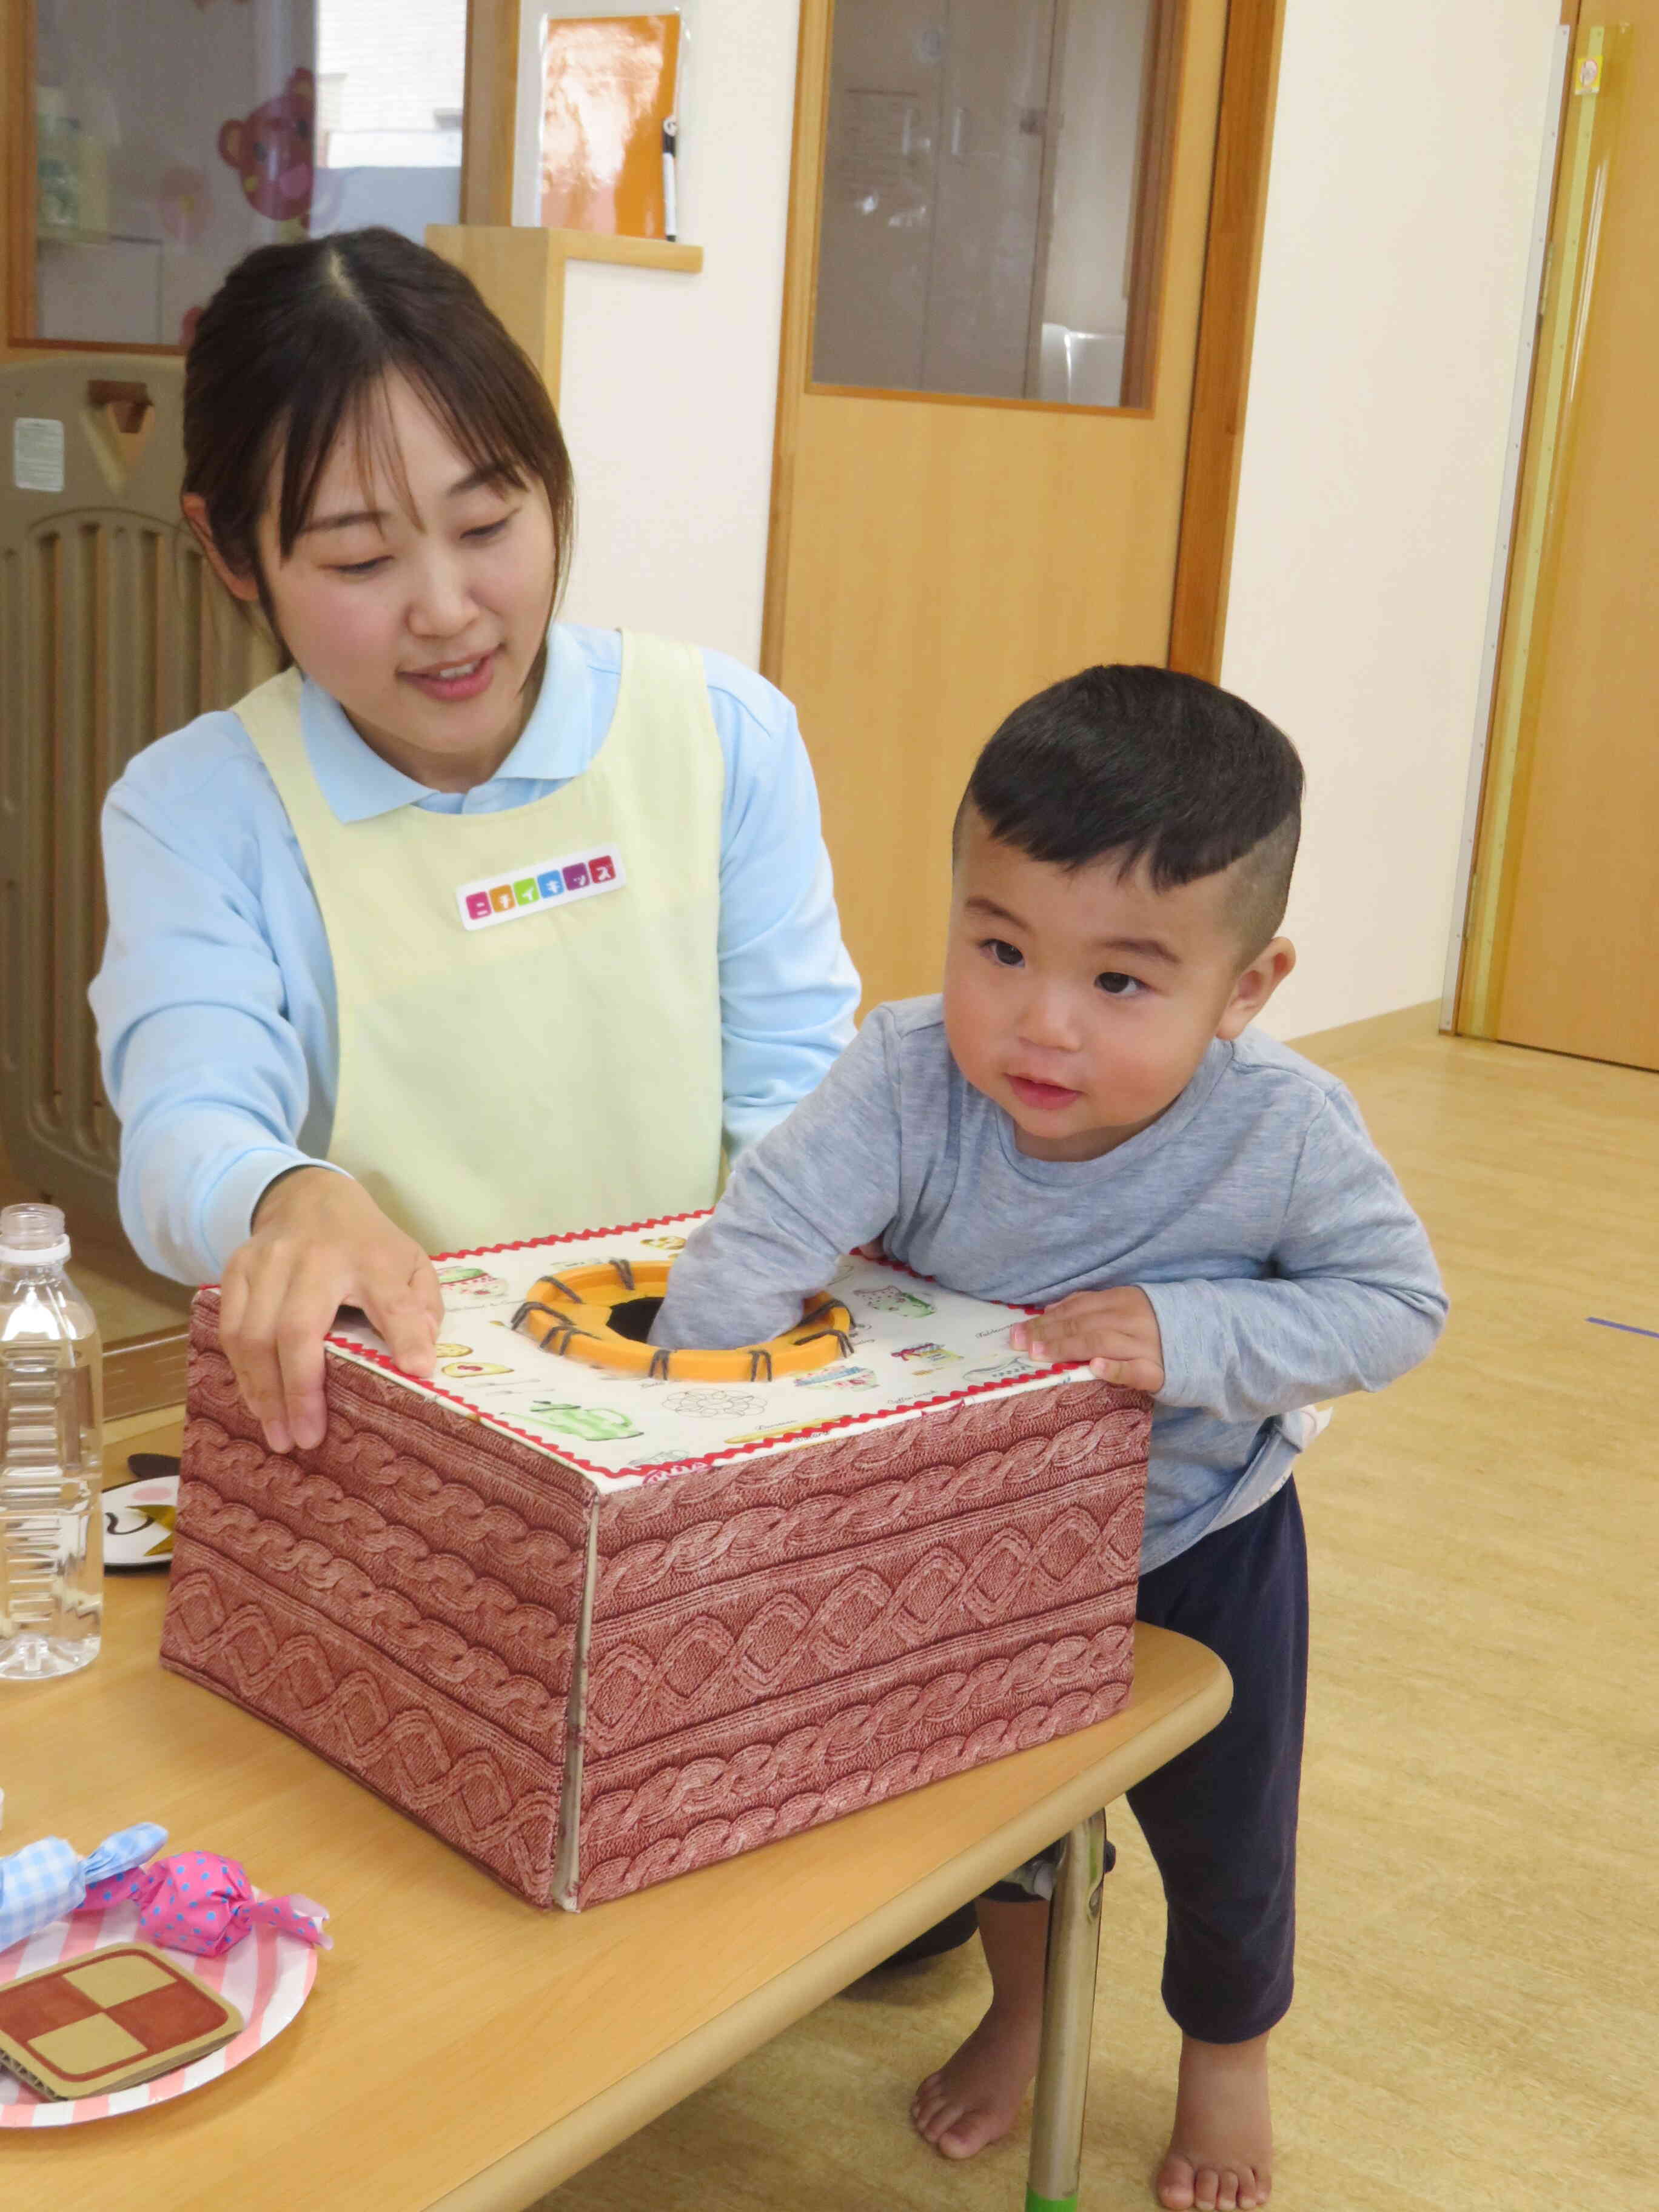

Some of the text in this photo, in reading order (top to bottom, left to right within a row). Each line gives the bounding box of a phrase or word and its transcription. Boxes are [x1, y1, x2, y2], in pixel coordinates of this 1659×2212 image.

[474, 860, 614, 917] ニチイキッズ
